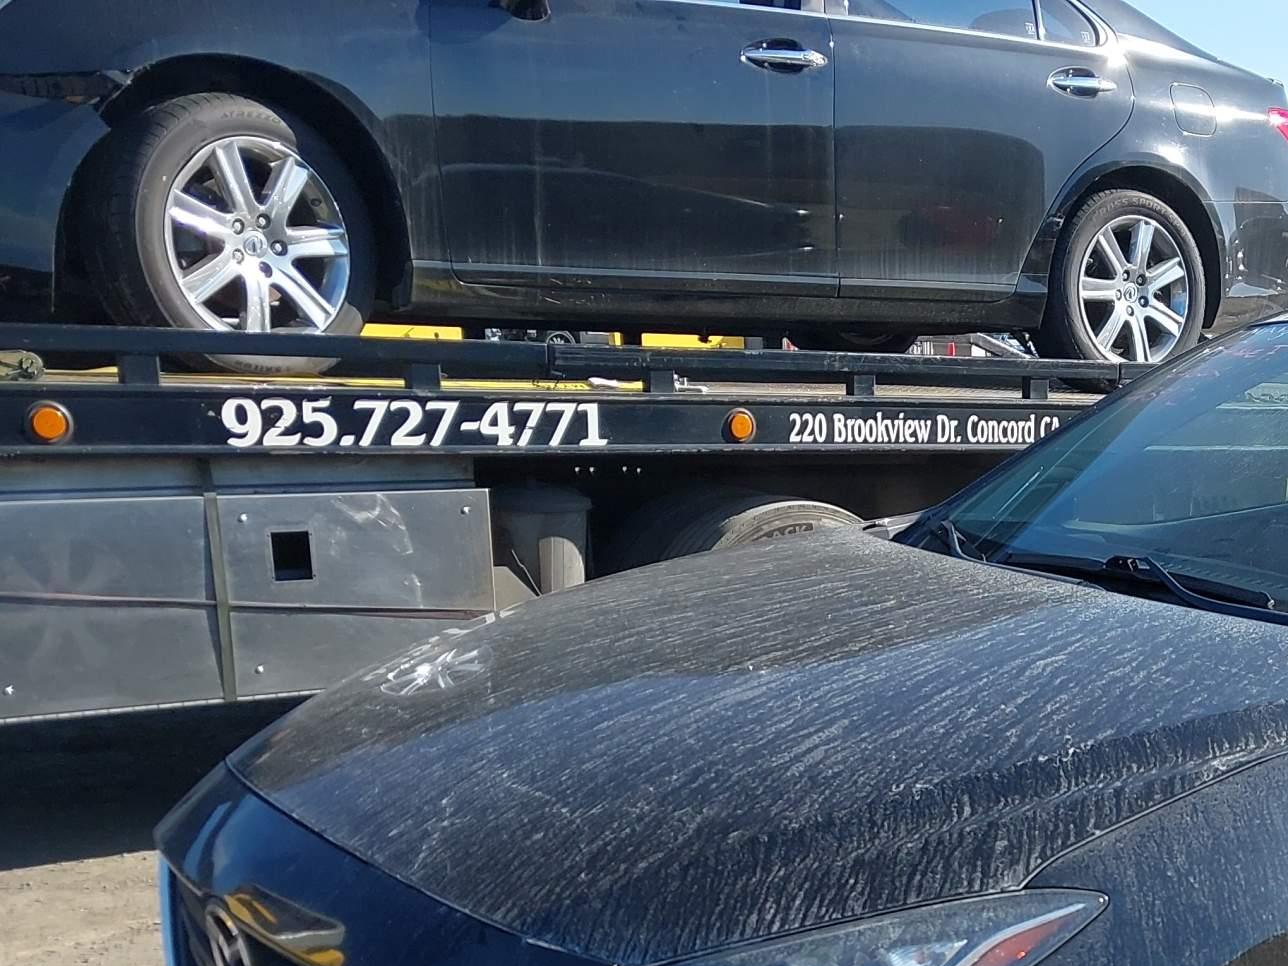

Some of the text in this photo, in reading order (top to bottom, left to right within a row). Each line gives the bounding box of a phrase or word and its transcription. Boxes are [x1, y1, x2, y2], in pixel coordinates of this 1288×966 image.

[221, 397, 609, 447] 925.727-4771
[789, 412, 827, 443] 220
[832, 412, 932, 443] Brookview
[937, 414, 962, 443] Dr.
[966, 414, 1036, 443] Concord
